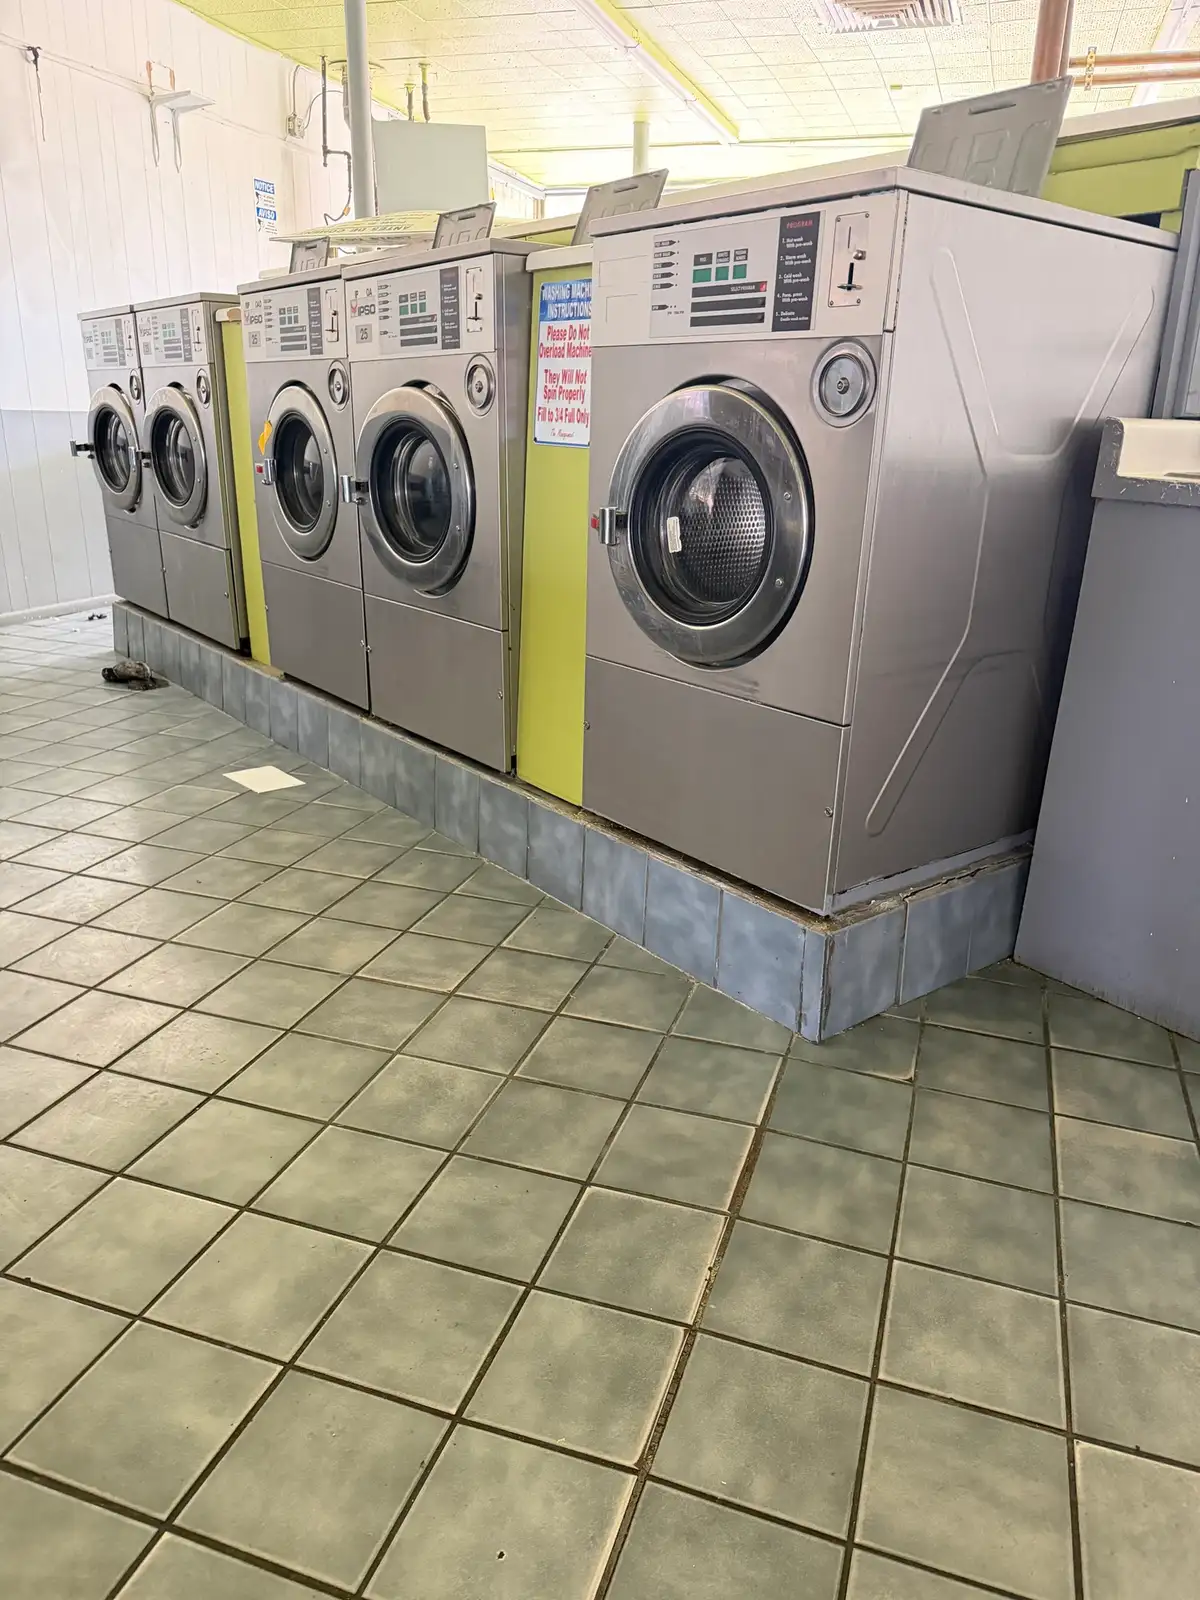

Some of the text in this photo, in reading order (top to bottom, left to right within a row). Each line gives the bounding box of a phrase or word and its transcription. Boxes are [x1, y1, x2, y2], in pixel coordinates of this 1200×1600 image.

[255, 181, 274, 194] NOTICE
[259, 208, 274, 220] AVISO
[786, 220, 813, 229] PROGRAM
[542, 284, 571, 301] WASHING
[358, 304, 376, 316] IPSO
[548, 301, 592, 318] INSTRUCTIONS
[360, 328, 368, 340] 25
[547, 324, 590, 340] Please Do Not
[540, 342, 564, 358] Overload
[544, 368, 587, 388] They Will Not
[544, 386, 585, 404] Spin Properly
[538, 406, 546, 421] Fill
[548, 408, 553, 422] to
[565, 408, 575, 423] Full
[576, 408, 589, 428] Only
